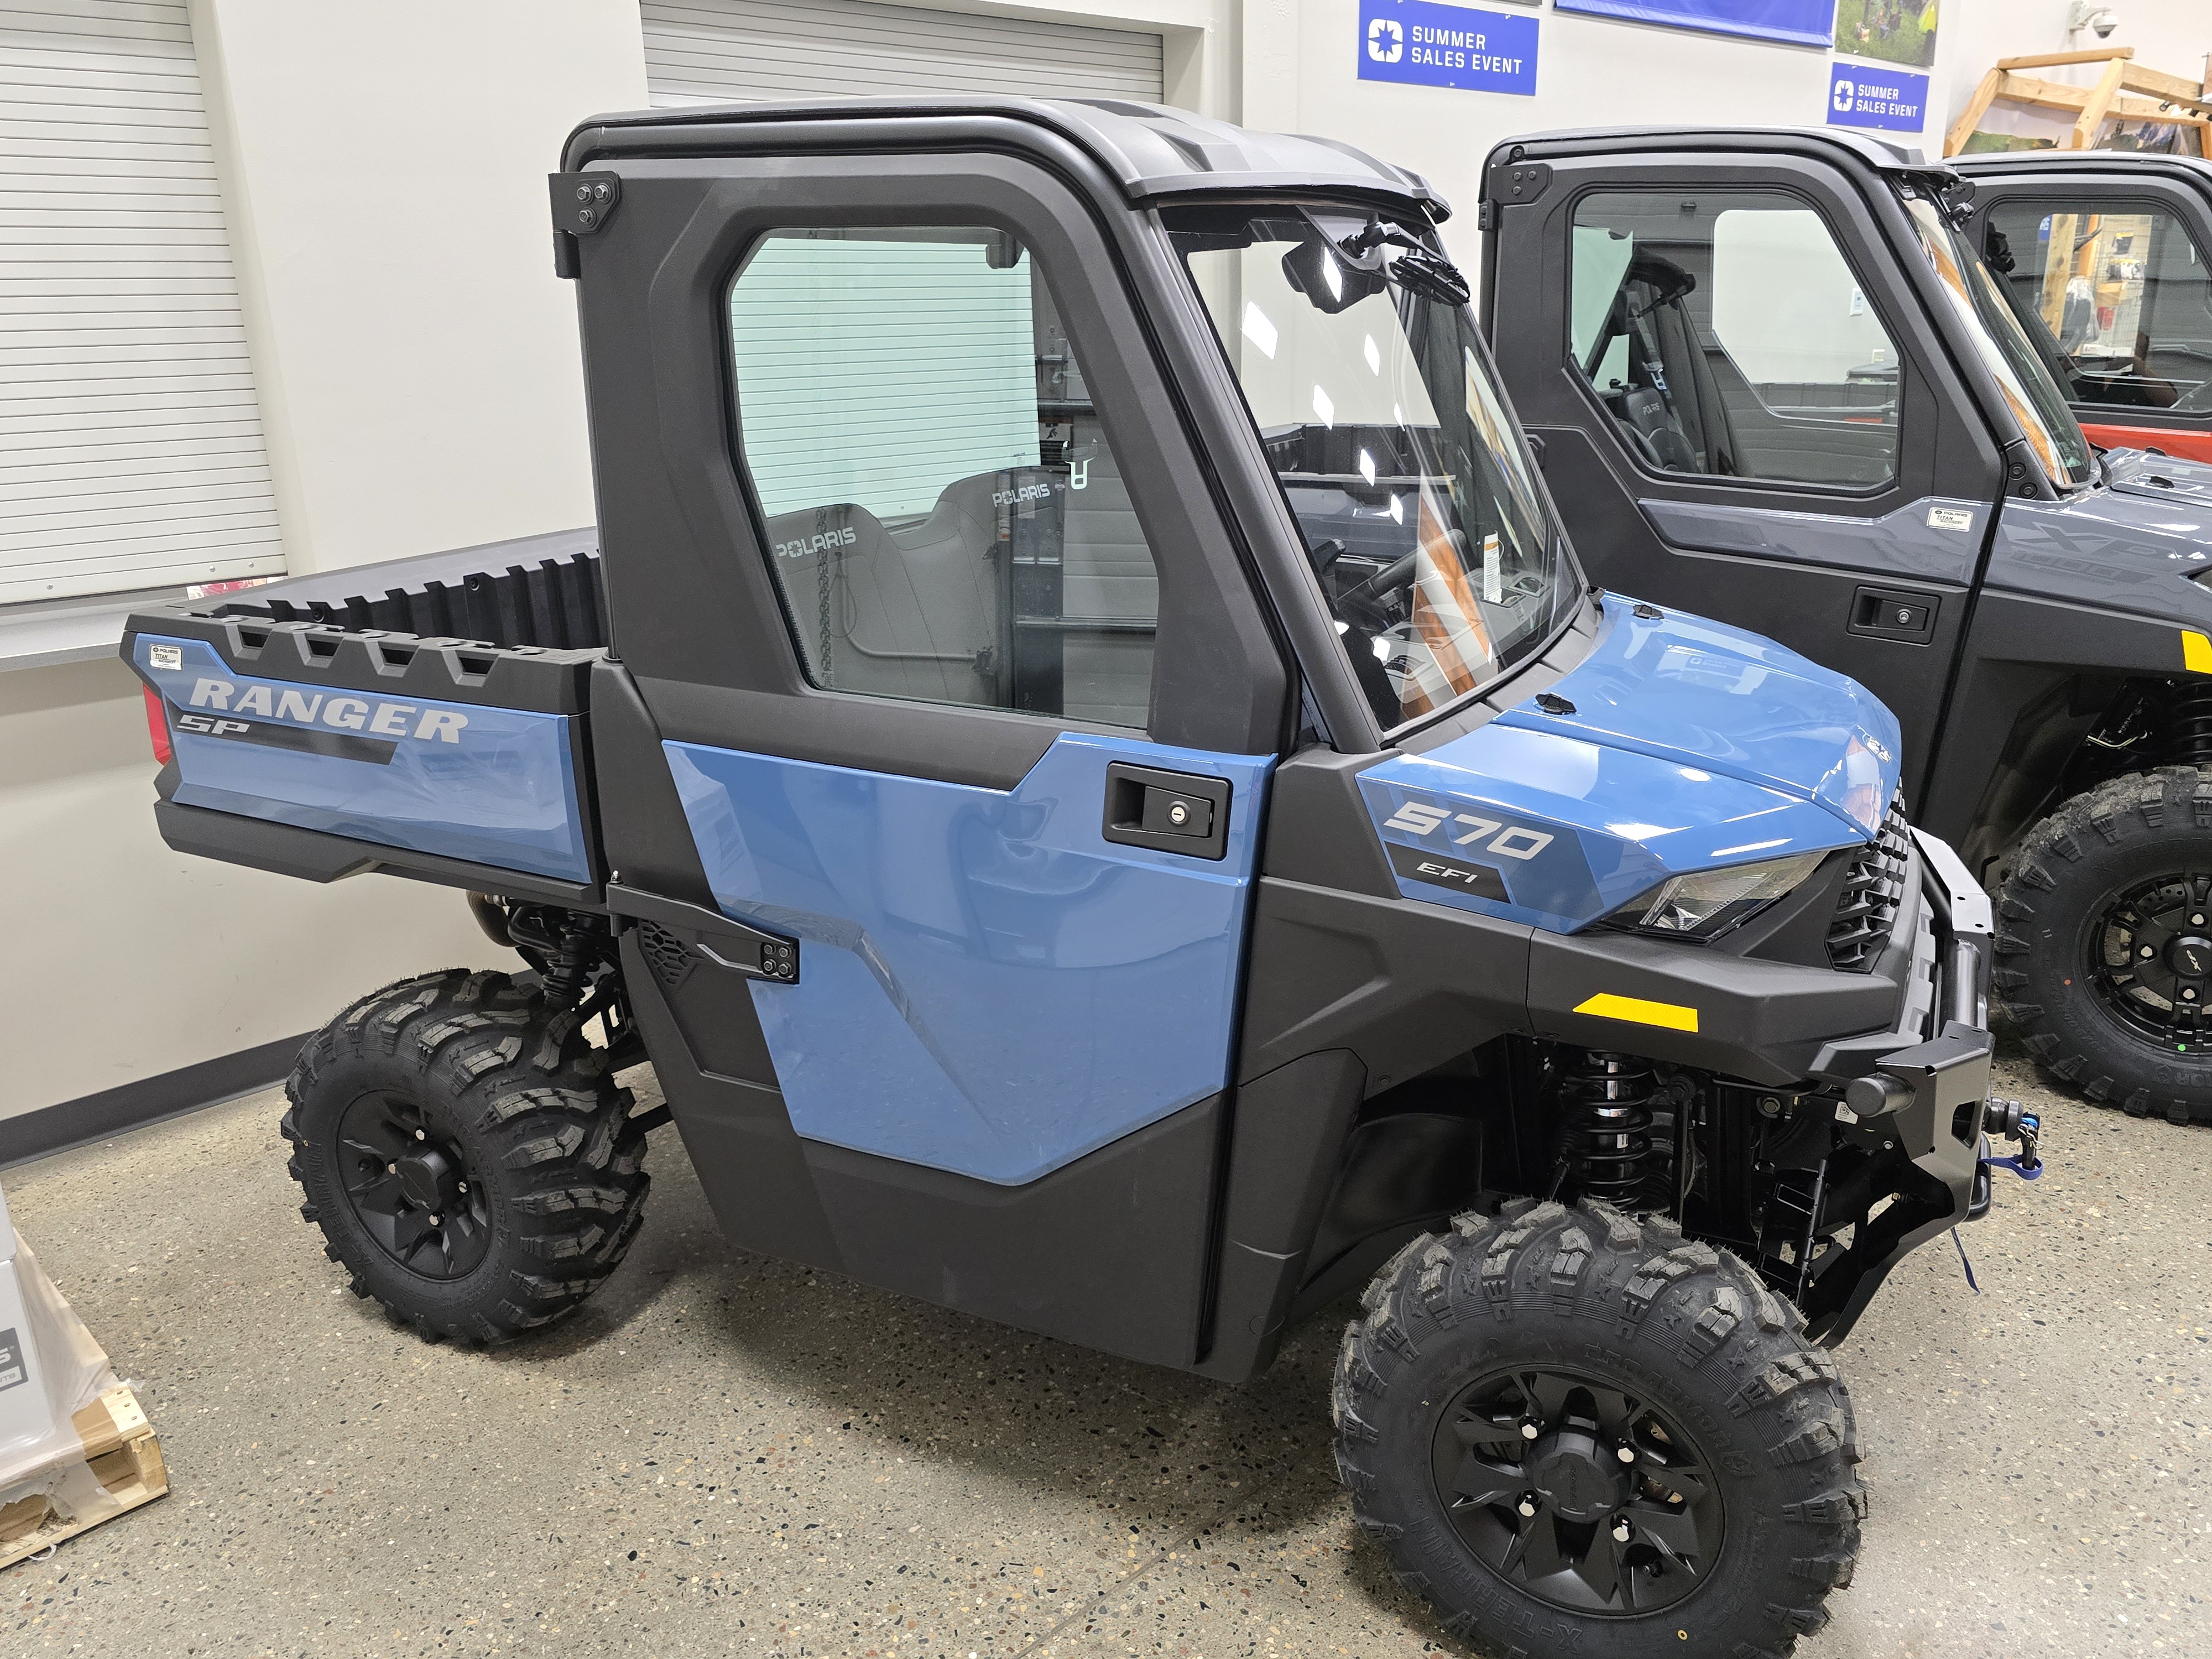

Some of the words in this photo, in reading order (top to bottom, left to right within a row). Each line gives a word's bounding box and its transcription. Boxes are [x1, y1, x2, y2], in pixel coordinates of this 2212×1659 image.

[1412, 25, 1486, 50] SUMMER
[1411, 47, 1465, 68] SALES
[1472, 55, 1522, 75] EVENT
[1858, 84, 1899, 101] SUMMER
[1856, 98, 1886, 114] SALES
[1888, 103, 1918, 118] EVENT
[992, 483, 1050, 507] POLARIS
[776, 526, 857, 558] POLARIS
[2011, 525, 2172, 560] XP
[189, 677, 468, 744] RANGER
[176, 714, 250, 735] SP
[1383, 801, 1554, 860] 570
[1416, 862, 1478, 883] EFI
[1408, 1516, 1583, 1655] X-TERRAIN
